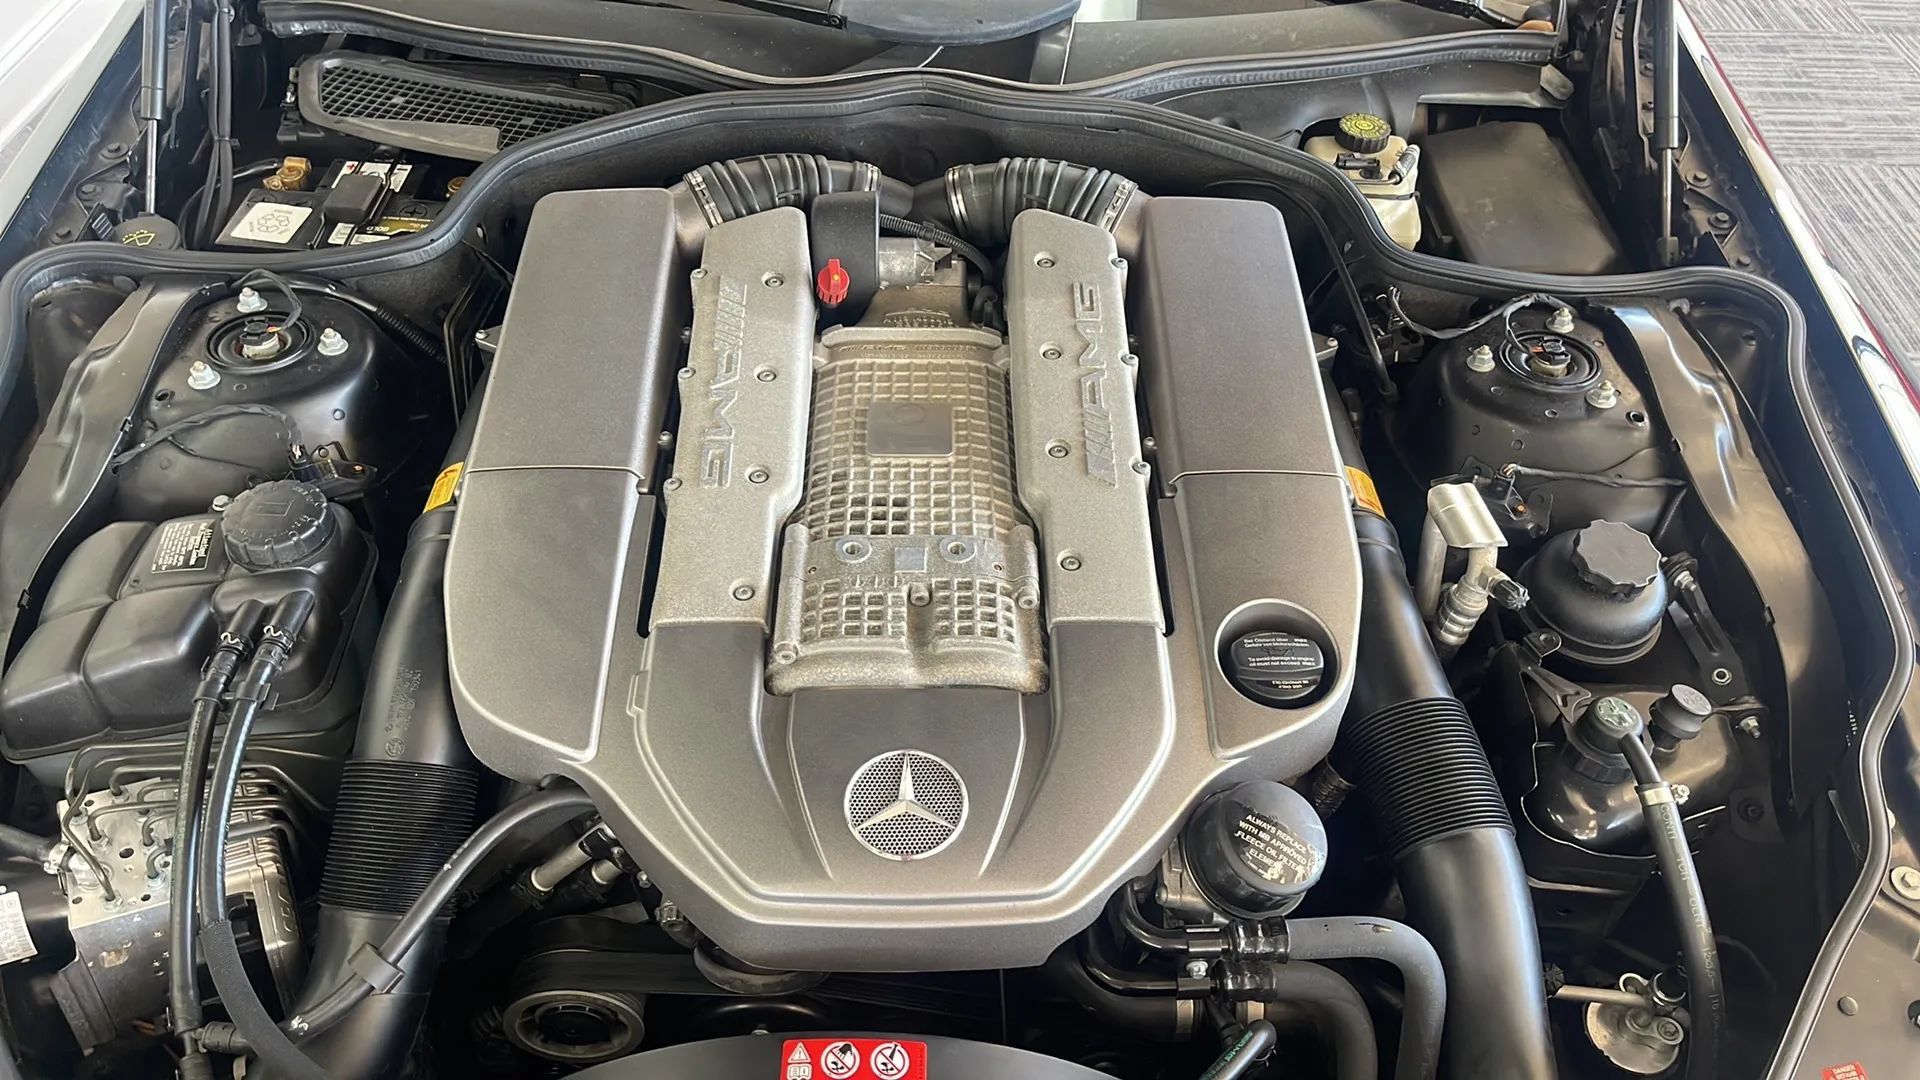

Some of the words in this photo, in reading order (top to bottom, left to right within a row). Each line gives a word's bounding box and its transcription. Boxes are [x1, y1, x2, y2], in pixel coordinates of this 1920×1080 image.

[1072, 282, 1109, 425] AMG
[701, 340, 743, 489] AMG
[1234, 830, 1264, 850] FLEECE
[1266, 846, 1278, 858] OIL
[1239, 820, 1259, 835] WITH
[1258, 831, 1271, 842] MB
[1270, 838, 1307, 865] APPROVED
[1246, 814, 1277, 834] ALWAYS
[1276, 829, 1307, 854] REPLACE
